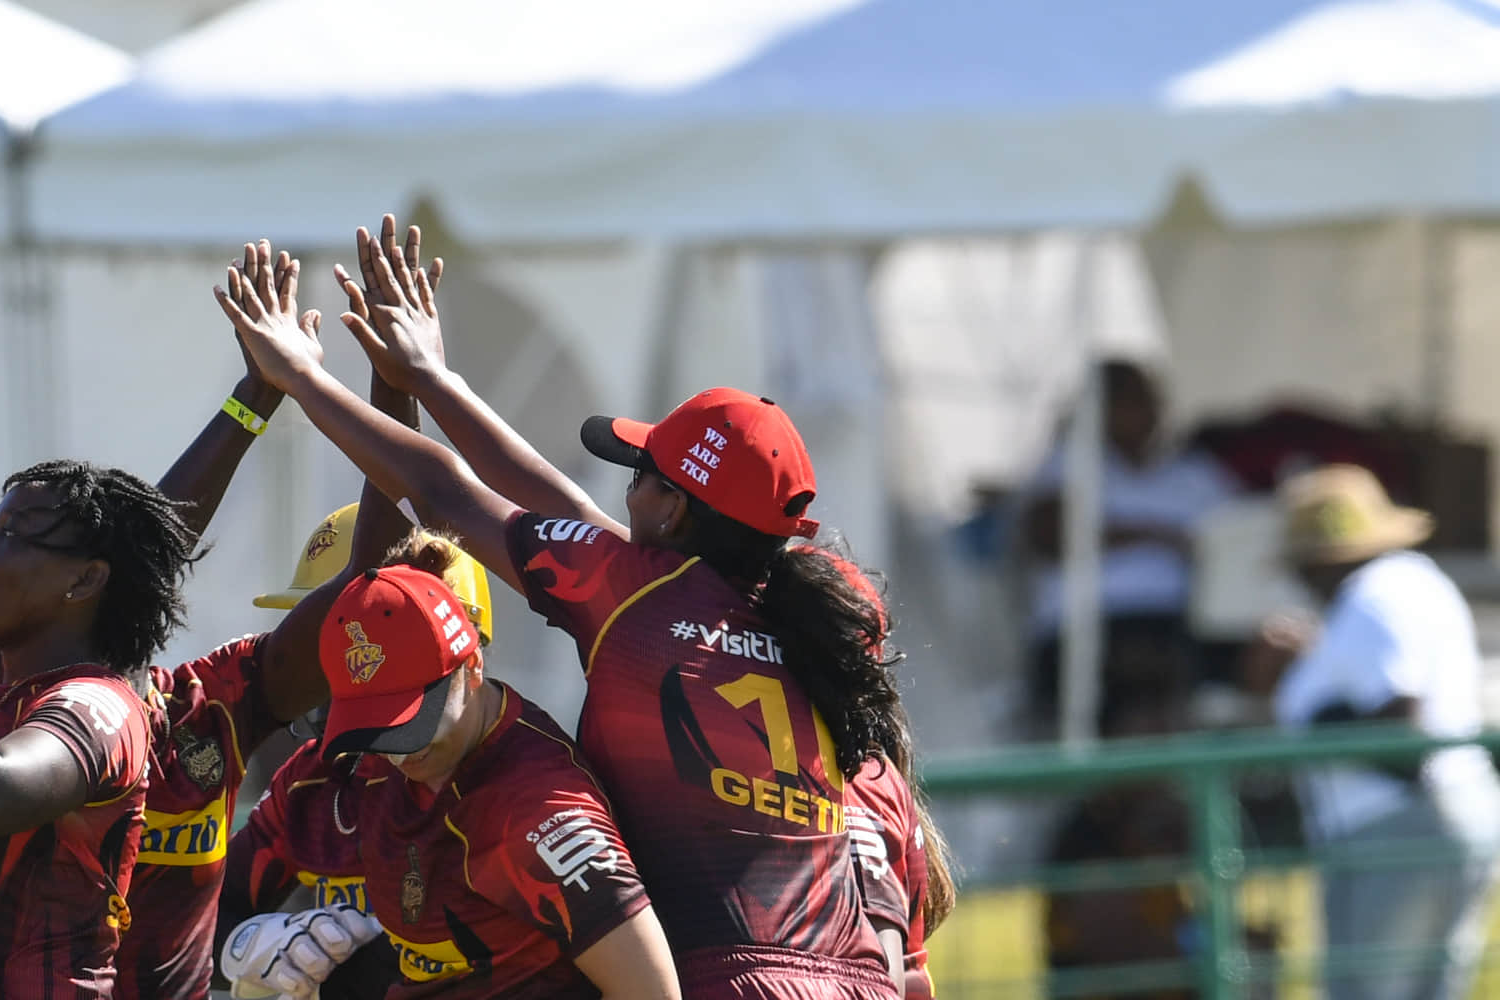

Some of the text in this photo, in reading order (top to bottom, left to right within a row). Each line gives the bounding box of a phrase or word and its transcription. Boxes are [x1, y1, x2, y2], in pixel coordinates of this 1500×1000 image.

[704, 427, 728, 451] WE
[687, 442, 721, 470] ARE
[680, 457, 710, 486] TKR
